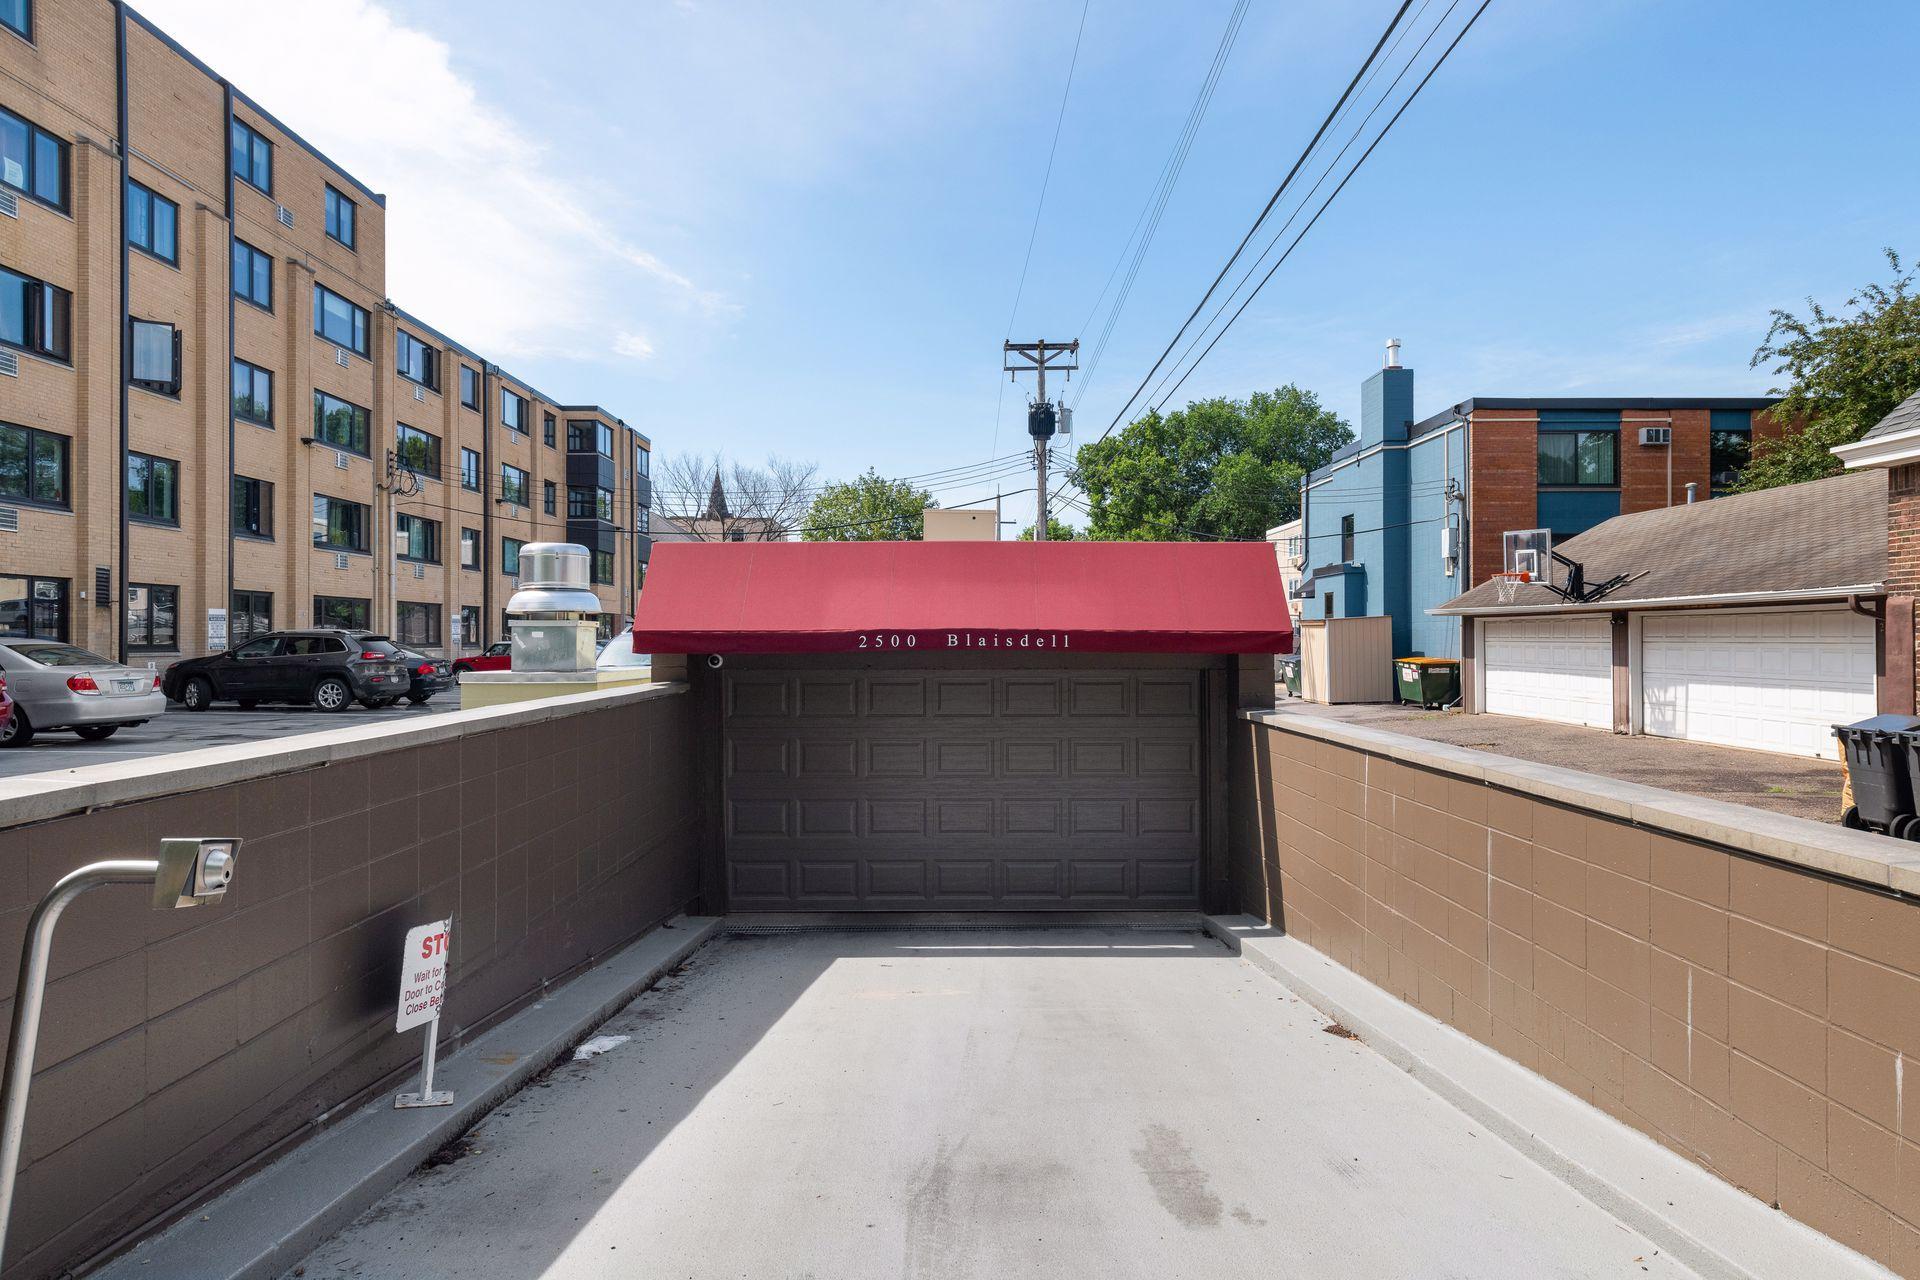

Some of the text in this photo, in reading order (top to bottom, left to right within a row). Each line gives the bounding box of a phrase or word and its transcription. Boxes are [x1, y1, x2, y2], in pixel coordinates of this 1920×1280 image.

[858, 633, 1069, 647] 2500 Blaisdell
[414, 967, 443, 983] Wait for
[405, 989, 423, 1001] Door
[425, 984, 433, 994] to
[406, 1001, 427, 1015] Close
